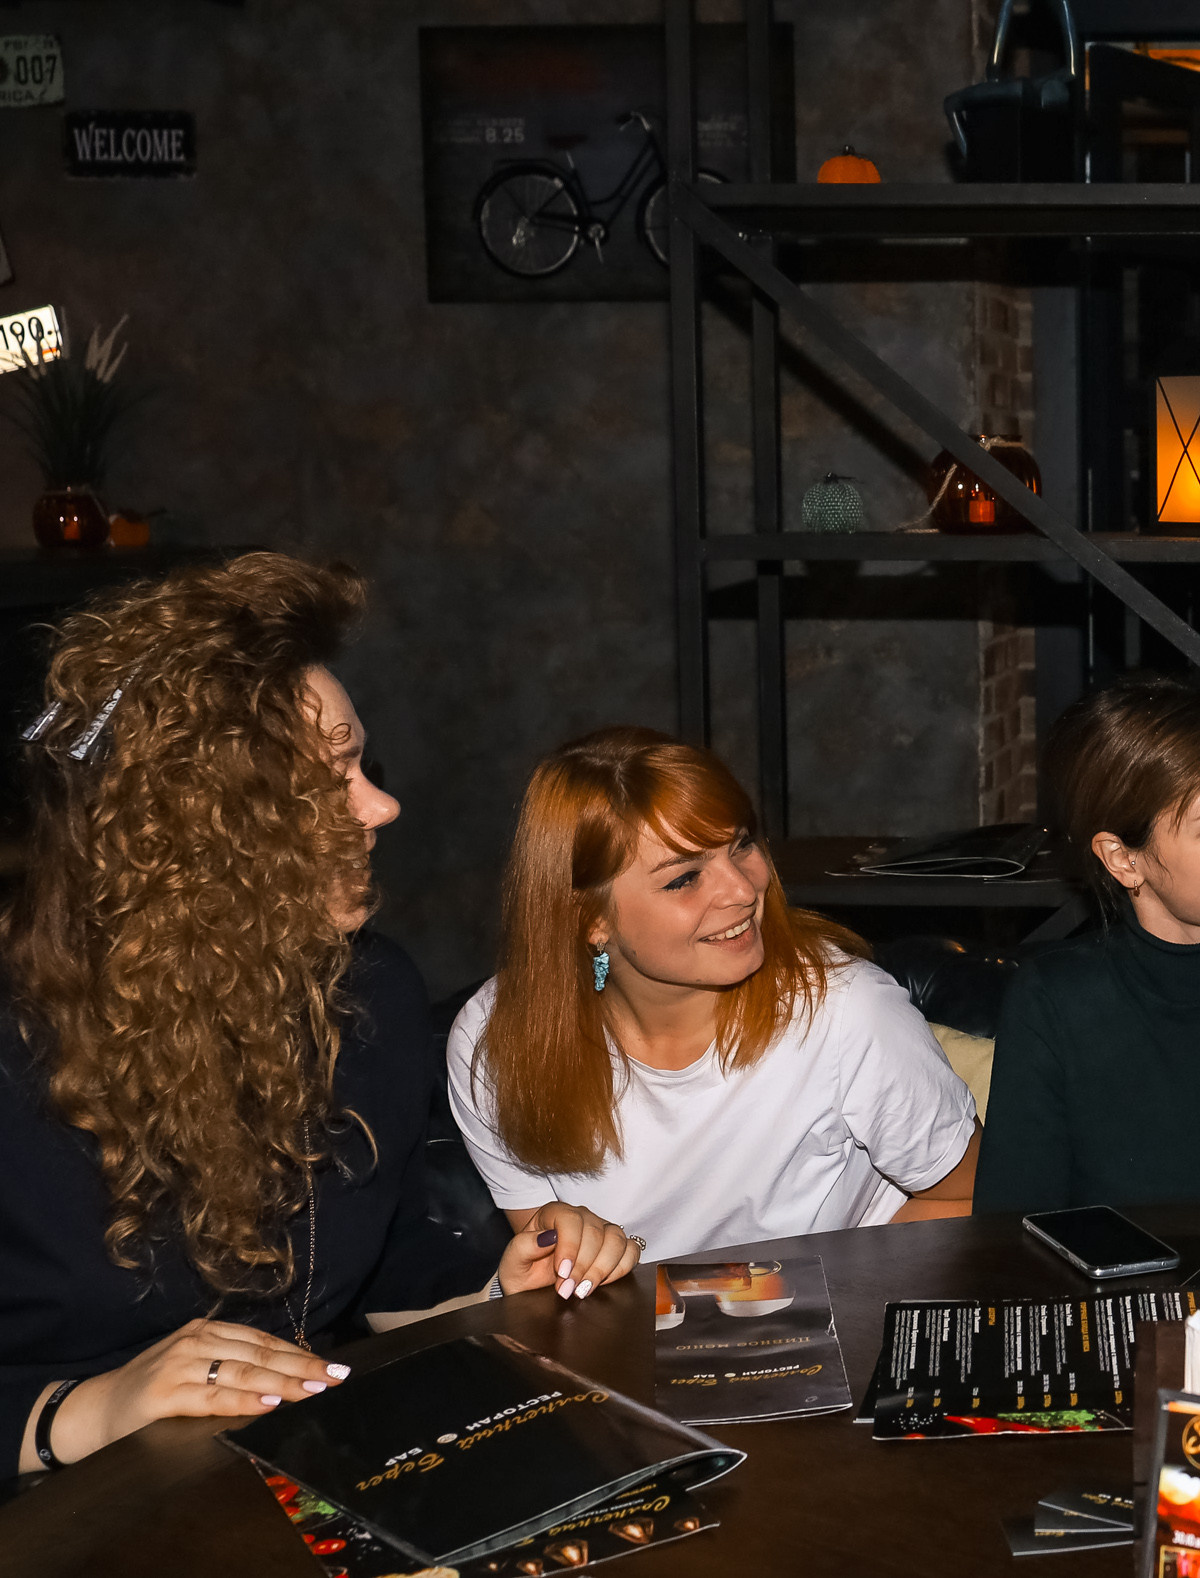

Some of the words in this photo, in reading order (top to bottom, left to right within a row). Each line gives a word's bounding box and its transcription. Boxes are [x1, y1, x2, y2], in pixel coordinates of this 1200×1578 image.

[15, 54, 57, 85] 007
[73, 121, 187, 163] WELCOME
[742, 1364, 800, 1376] РЕСТОРАН
[454, 1389, 609, 1451] Солнечный
[464, 1390, 563, 1432] РЕСТОРАН
[354, 1451, 445, 1492] Берег
[384, 1446, 423, 1467] БАР
